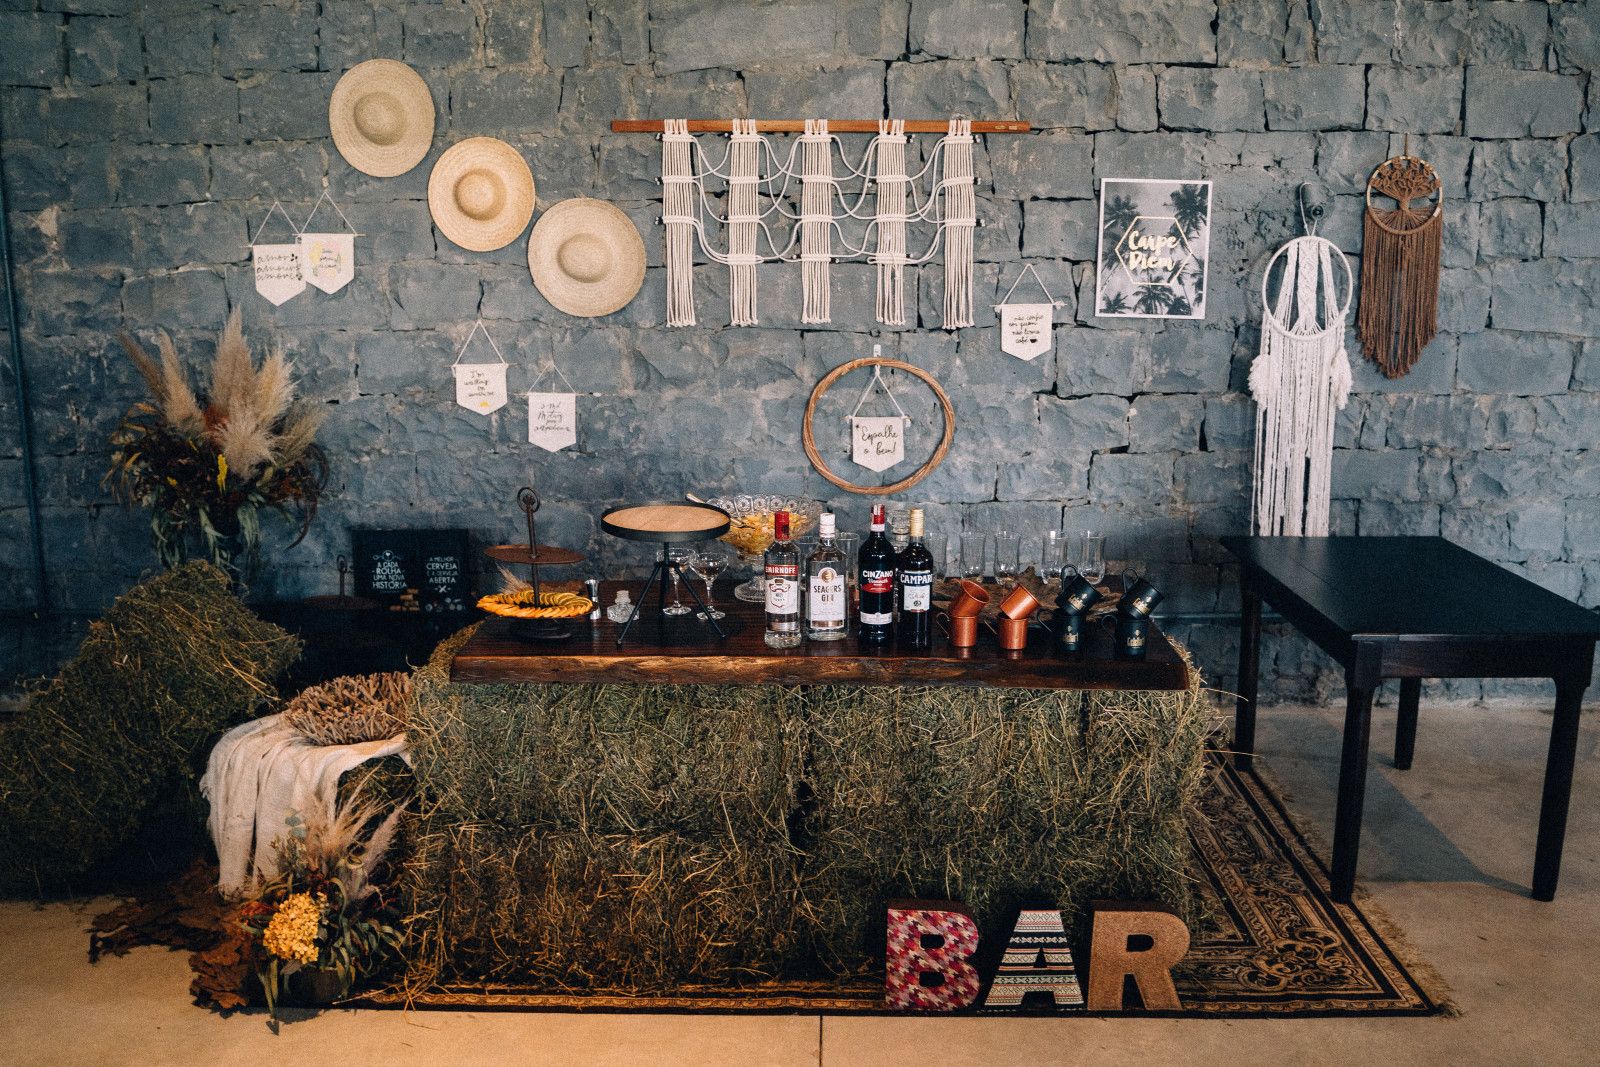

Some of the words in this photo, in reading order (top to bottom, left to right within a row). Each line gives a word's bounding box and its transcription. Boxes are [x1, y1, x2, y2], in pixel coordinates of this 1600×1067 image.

[1128, 230, 1177, 256] Carpe
[1129, 250, 1173, 271] Diem
[426, 562, 458, 570] CERVEJA
[376, 567, 401, 575] ROLHA
[862, 570, 893, 579] CINZANO
[429, 576, 457, 584] ABERTA
[813, 585, 842, 594] SEAGRS
[885, 908, 1191, 1011] BAR
